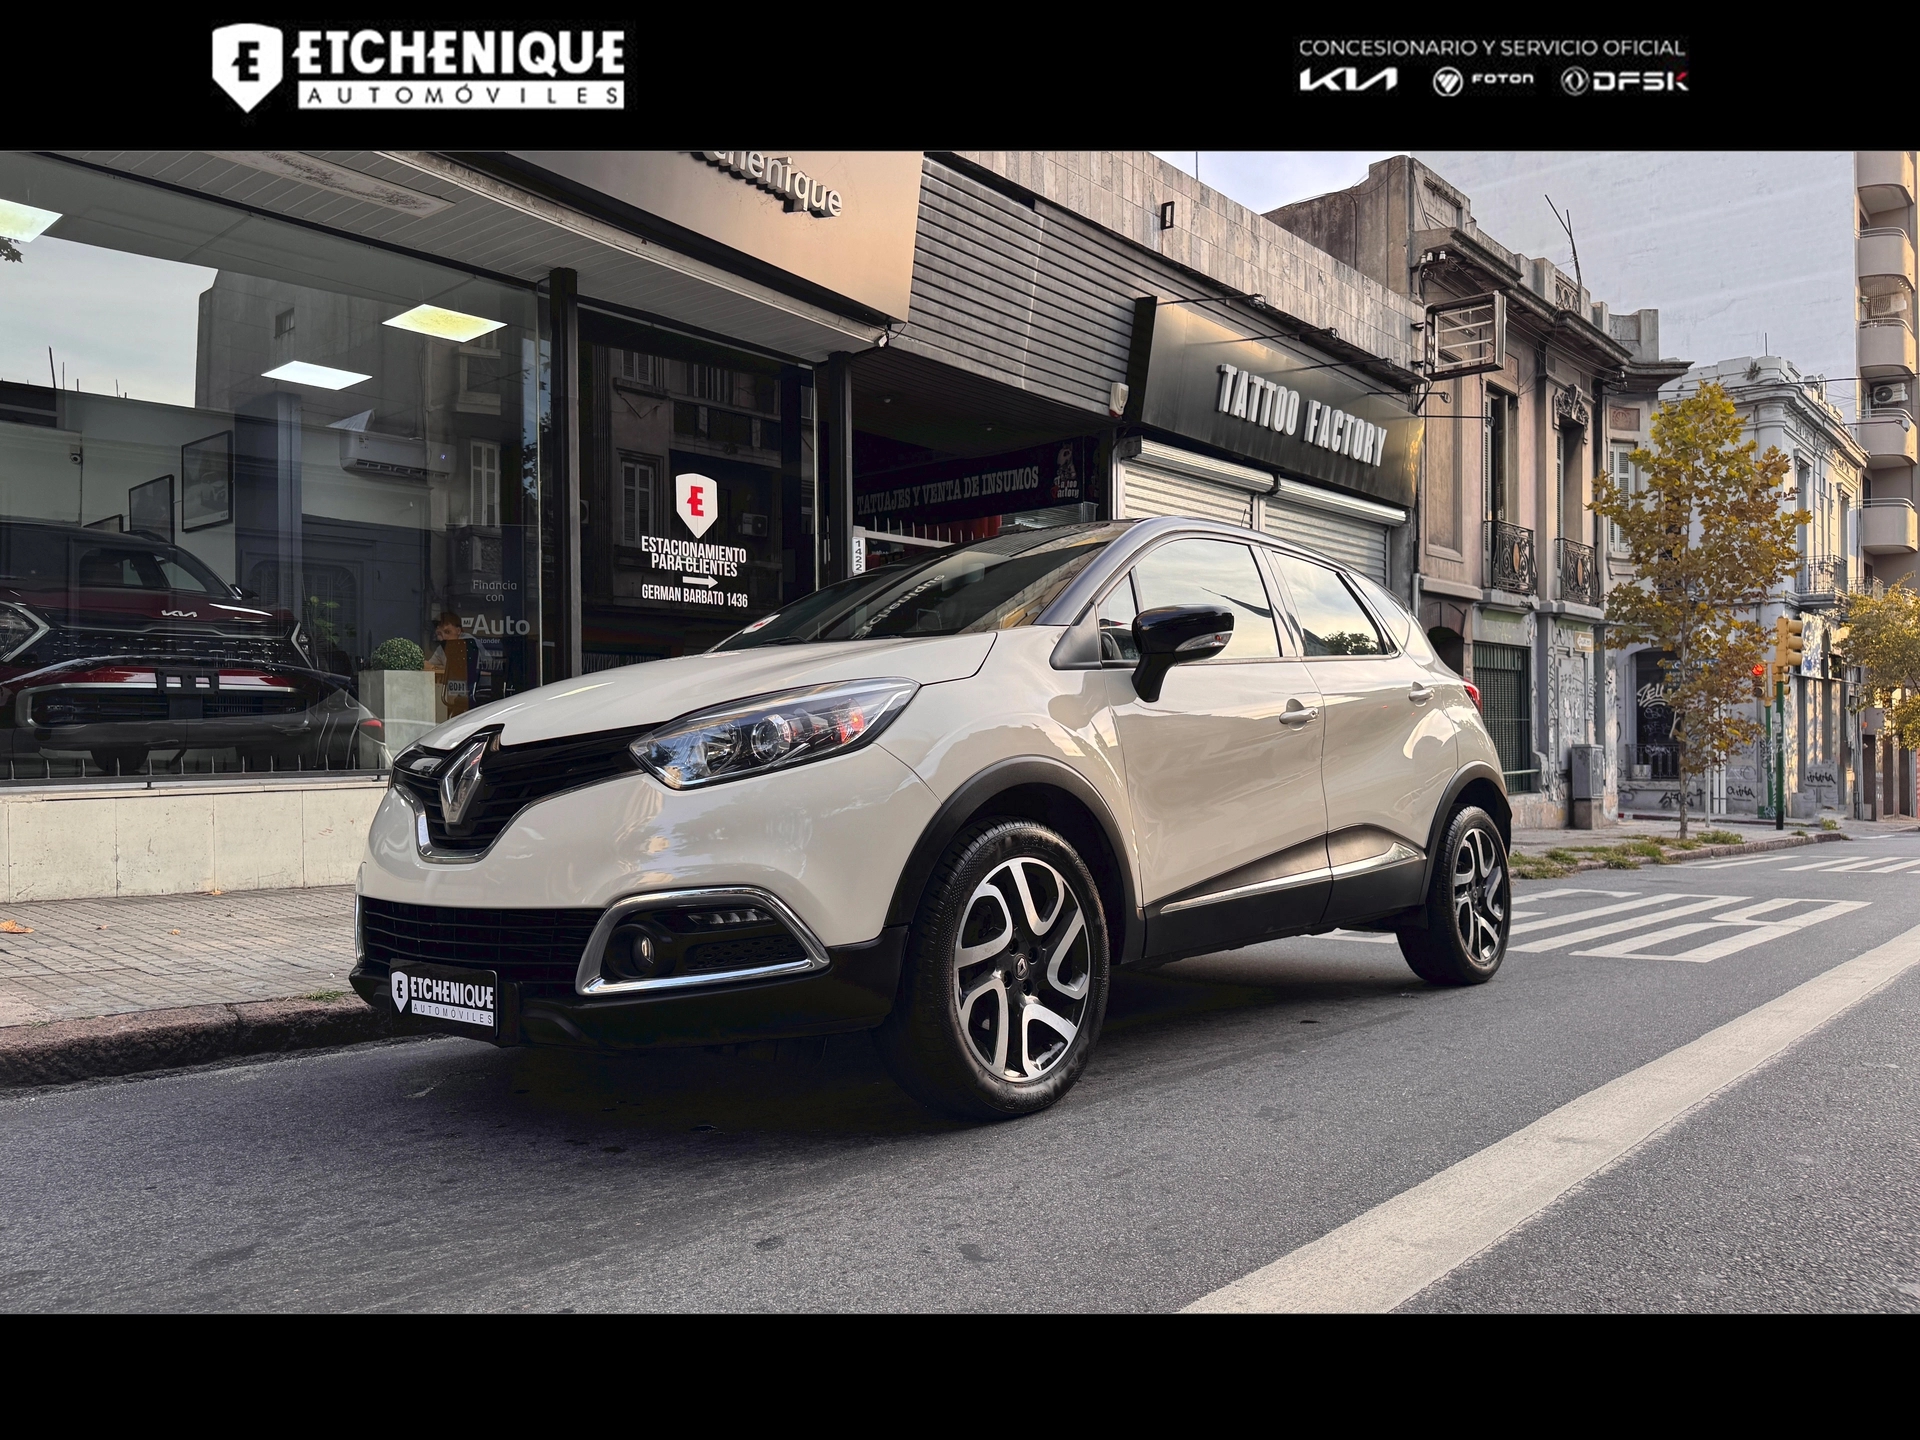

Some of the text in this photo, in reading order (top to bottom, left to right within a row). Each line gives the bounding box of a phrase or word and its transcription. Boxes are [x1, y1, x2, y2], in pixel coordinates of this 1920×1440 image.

[1218, 363, 1388, 467] TATTOO FACTORY
[857, 465, 1039, 516] TATUAJES Y VENTA DE INSUMOS
[641, 535, 747, 564] ESTACIONAMIENTO
[855, 540, 863, 572] 1422
[651, 553, 738, 577] PARA CLIENTES
[473, 580, 517, 590] Financia
[642, 584, 748, 608] GERMAN BARBATO 1436
[486, 594, 504, 602] con
[161, 610, 197, 618] KIA
[472, 614, 530, 635] Auto
[410, 976, 494, 1009] ETCHENIQUE
[413, 1003, 493, 1025] AUTOMÓVILES
